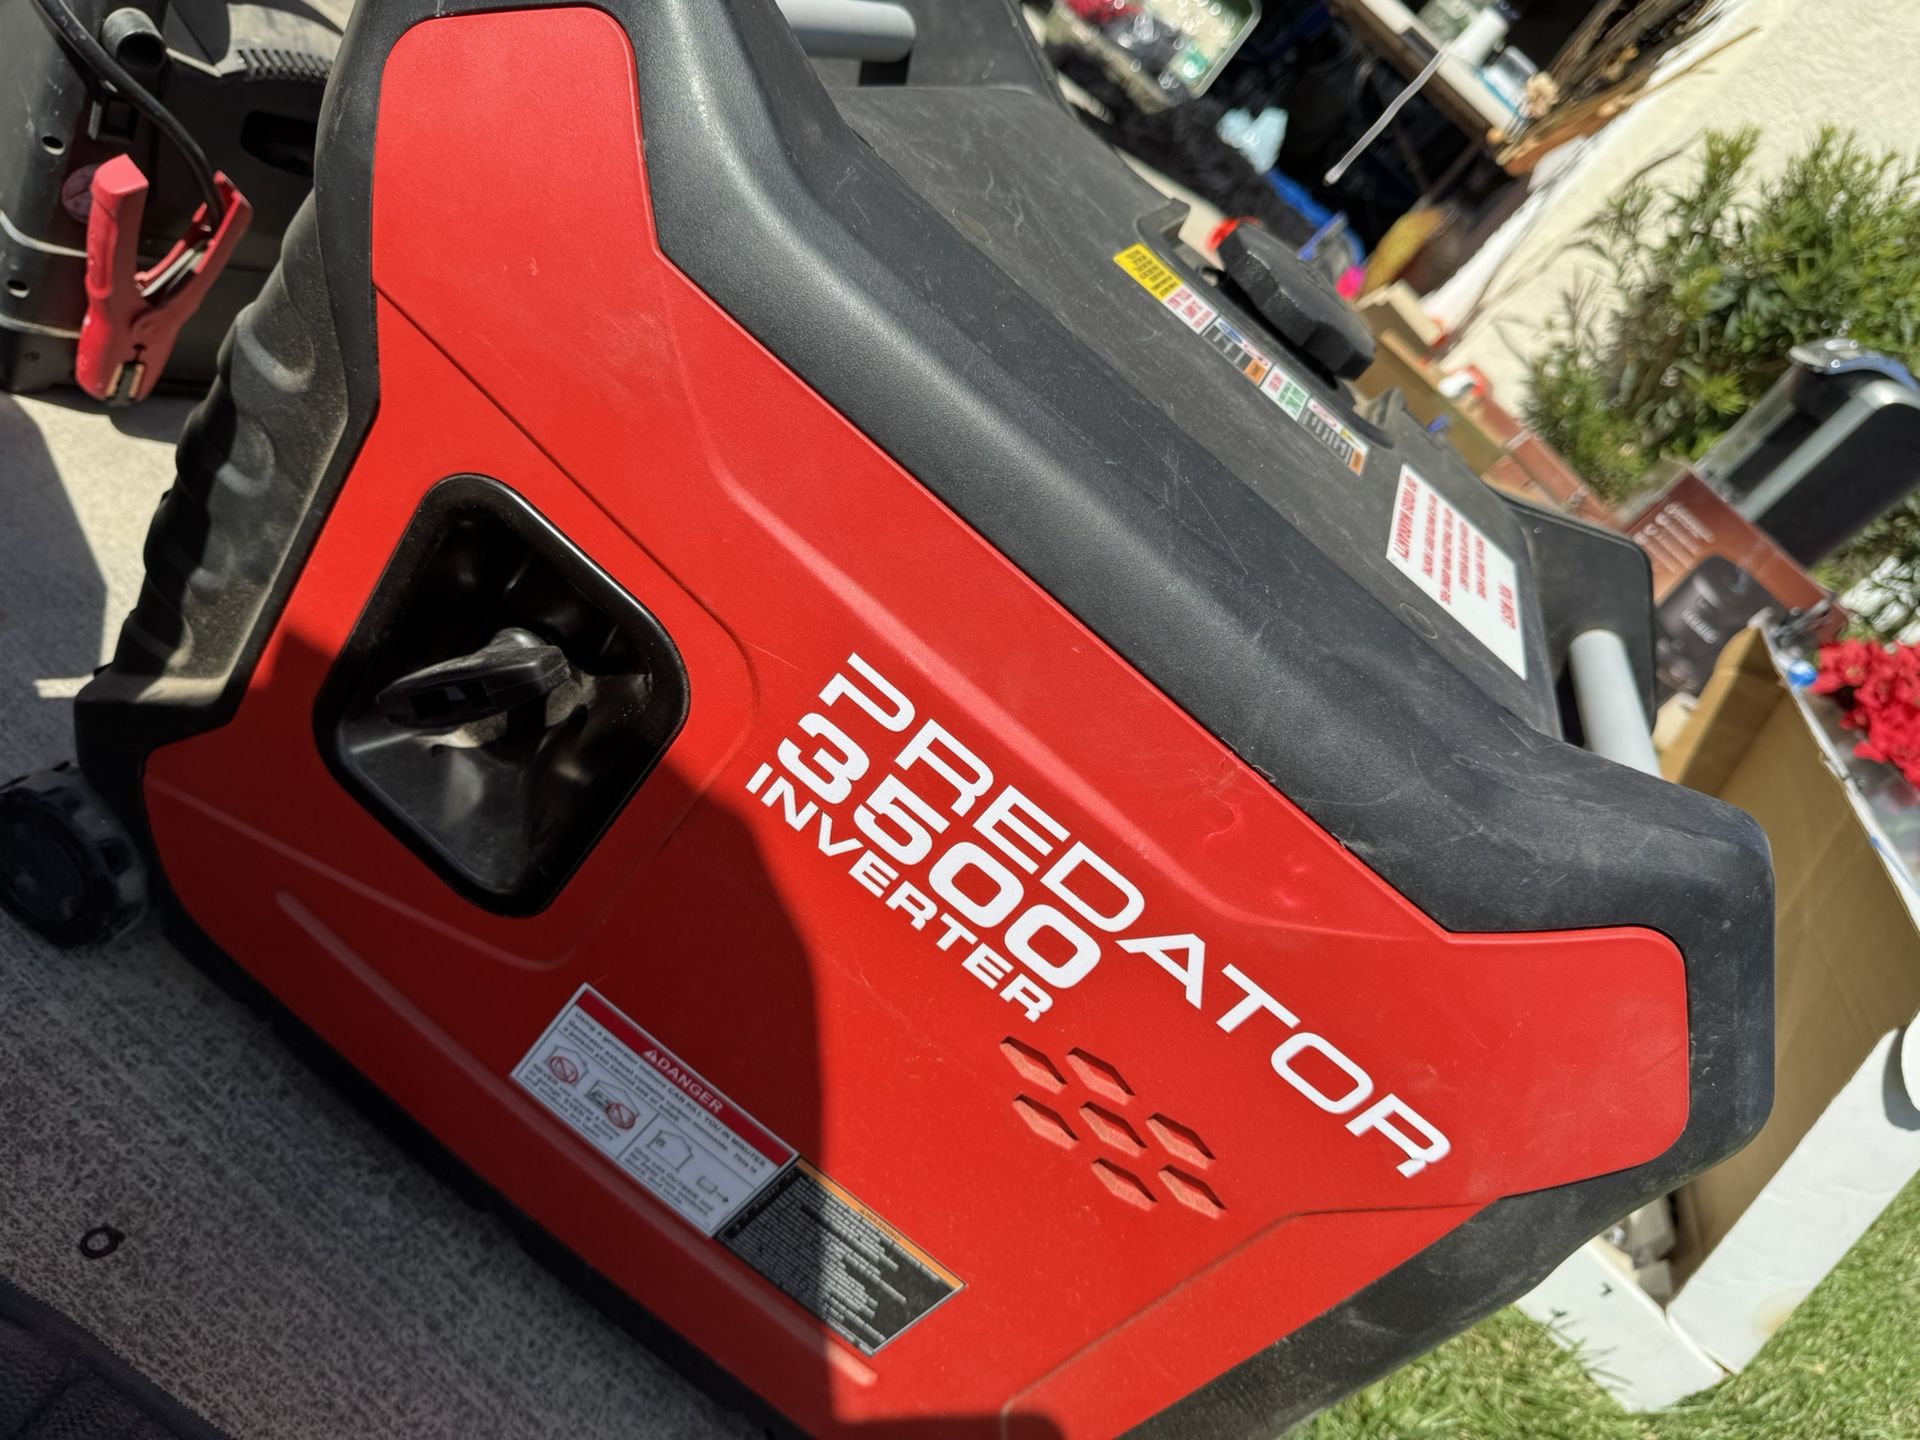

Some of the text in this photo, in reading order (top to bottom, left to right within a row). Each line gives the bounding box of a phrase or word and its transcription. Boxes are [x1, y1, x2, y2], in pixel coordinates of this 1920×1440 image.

[745, 762, 1053, 1022] INVERTER
[777, 712, 1101, 989] 3500
[818, 652, 1451, 1178] PREDATOR
[567, 1019, 604, 1050] Generator
[733, 1153, 750, 1167] This
[602, 1034, 638, 1065] generator
[667, 1087, 685, 1102] CAN
[685, 1101, 702, 1116] KILL
[703, 1116, 721, 1131] YOU
[655, 1055, 724, 1113] DANGER
